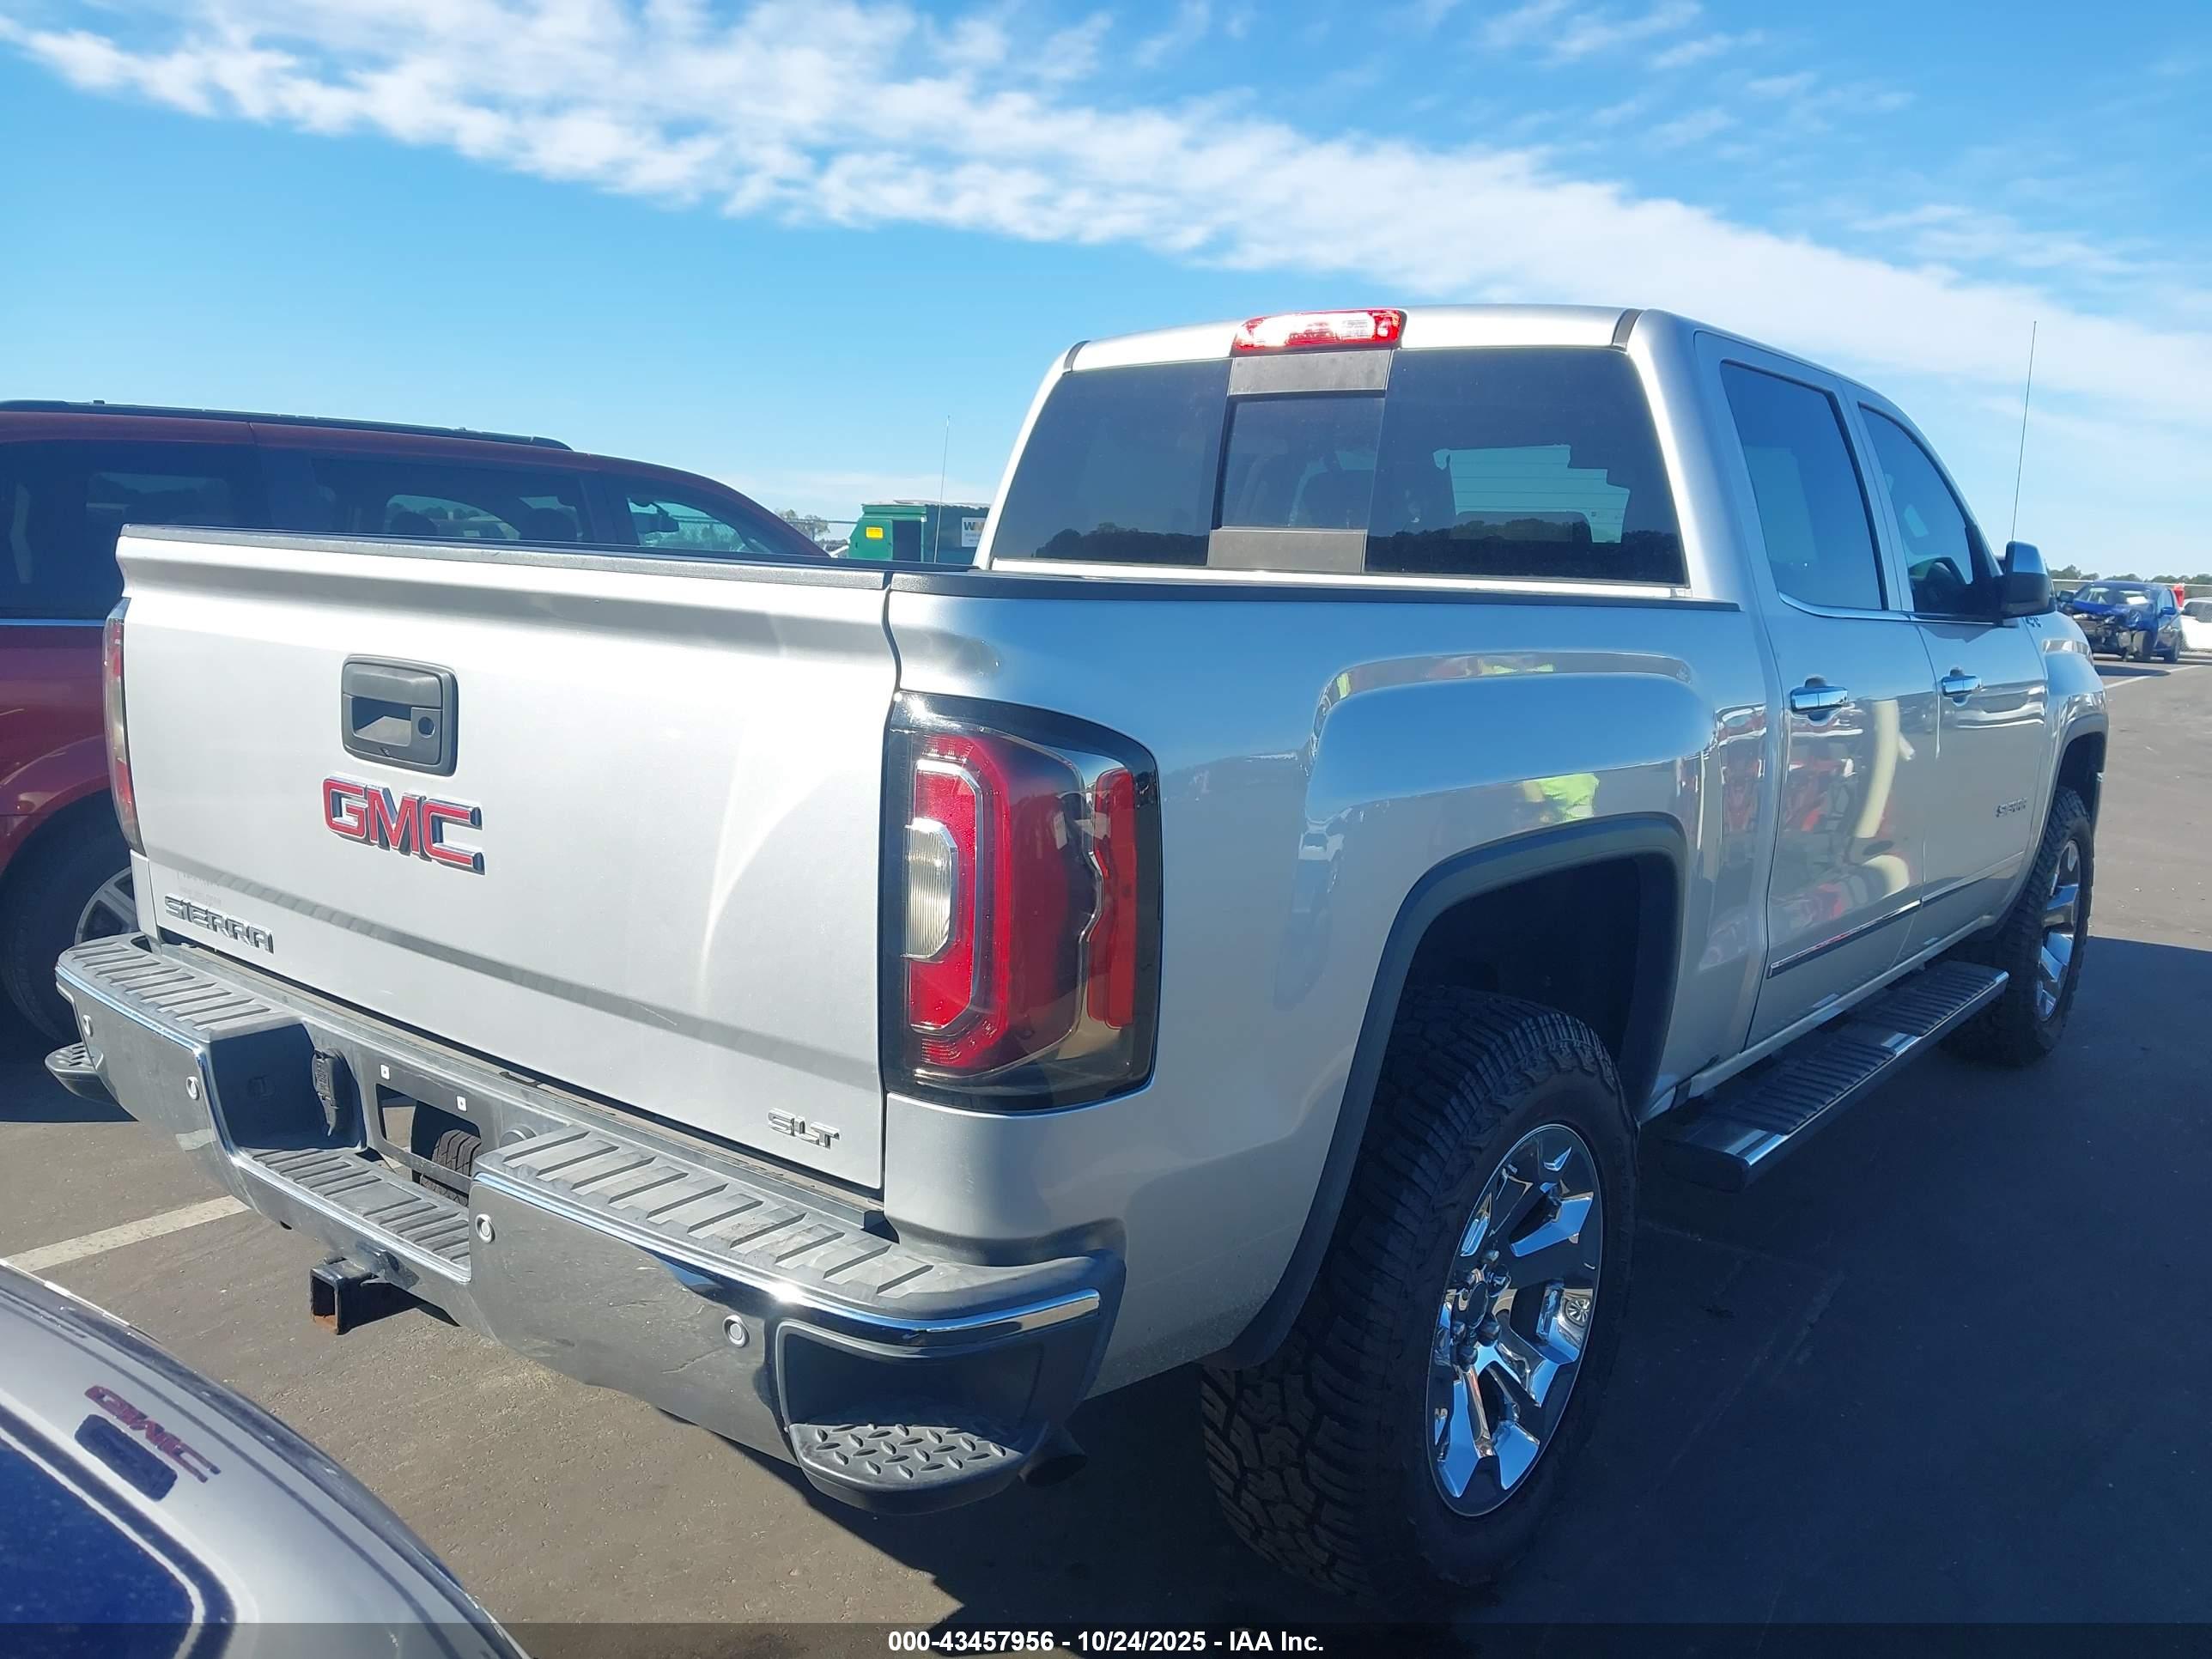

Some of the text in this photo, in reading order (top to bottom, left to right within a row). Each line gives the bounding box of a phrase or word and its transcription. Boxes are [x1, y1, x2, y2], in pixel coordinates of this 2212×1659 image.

[323, 775, 485, 875] GMC
[164, 894, 274, 954] SIERRA
[768, 1108, 841, 1149] SLT
[84, 1385, 221, 1483] GMC
